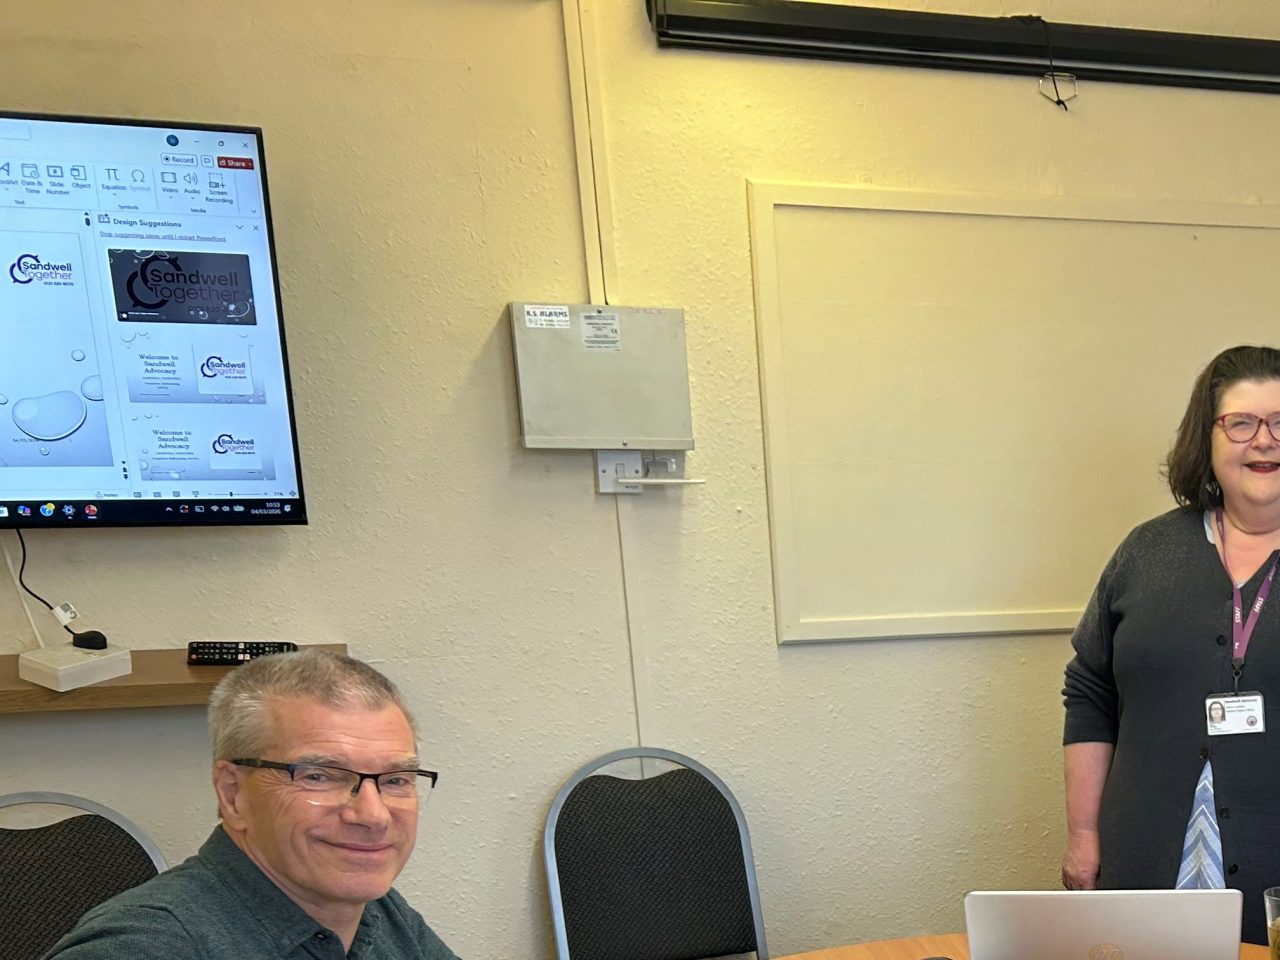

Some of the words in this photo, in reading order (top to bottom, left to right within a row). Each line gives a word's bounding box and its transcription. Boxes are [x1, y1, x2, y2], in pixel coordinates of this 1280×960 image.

[172, 156, 195, 164] Record
[227, 159, 246, 168] Share
[113, 218, 138, 227] Design
[139, 219, 182, 229] Suggestions
[22, 261, 73, 272] Sandwell
[23, 269, 73, 281] Together
[150, 268, 239, 287] Sandwell
[151, 283, 240, 304] Together
[209, 360, 246, 369] Sandwell
[144, 367, 177, 375] Advocacy
[211, 367, 246, 376] Together
[221, 438, 255, 446] Sandwell
[222, 444, 255, 452] Together
